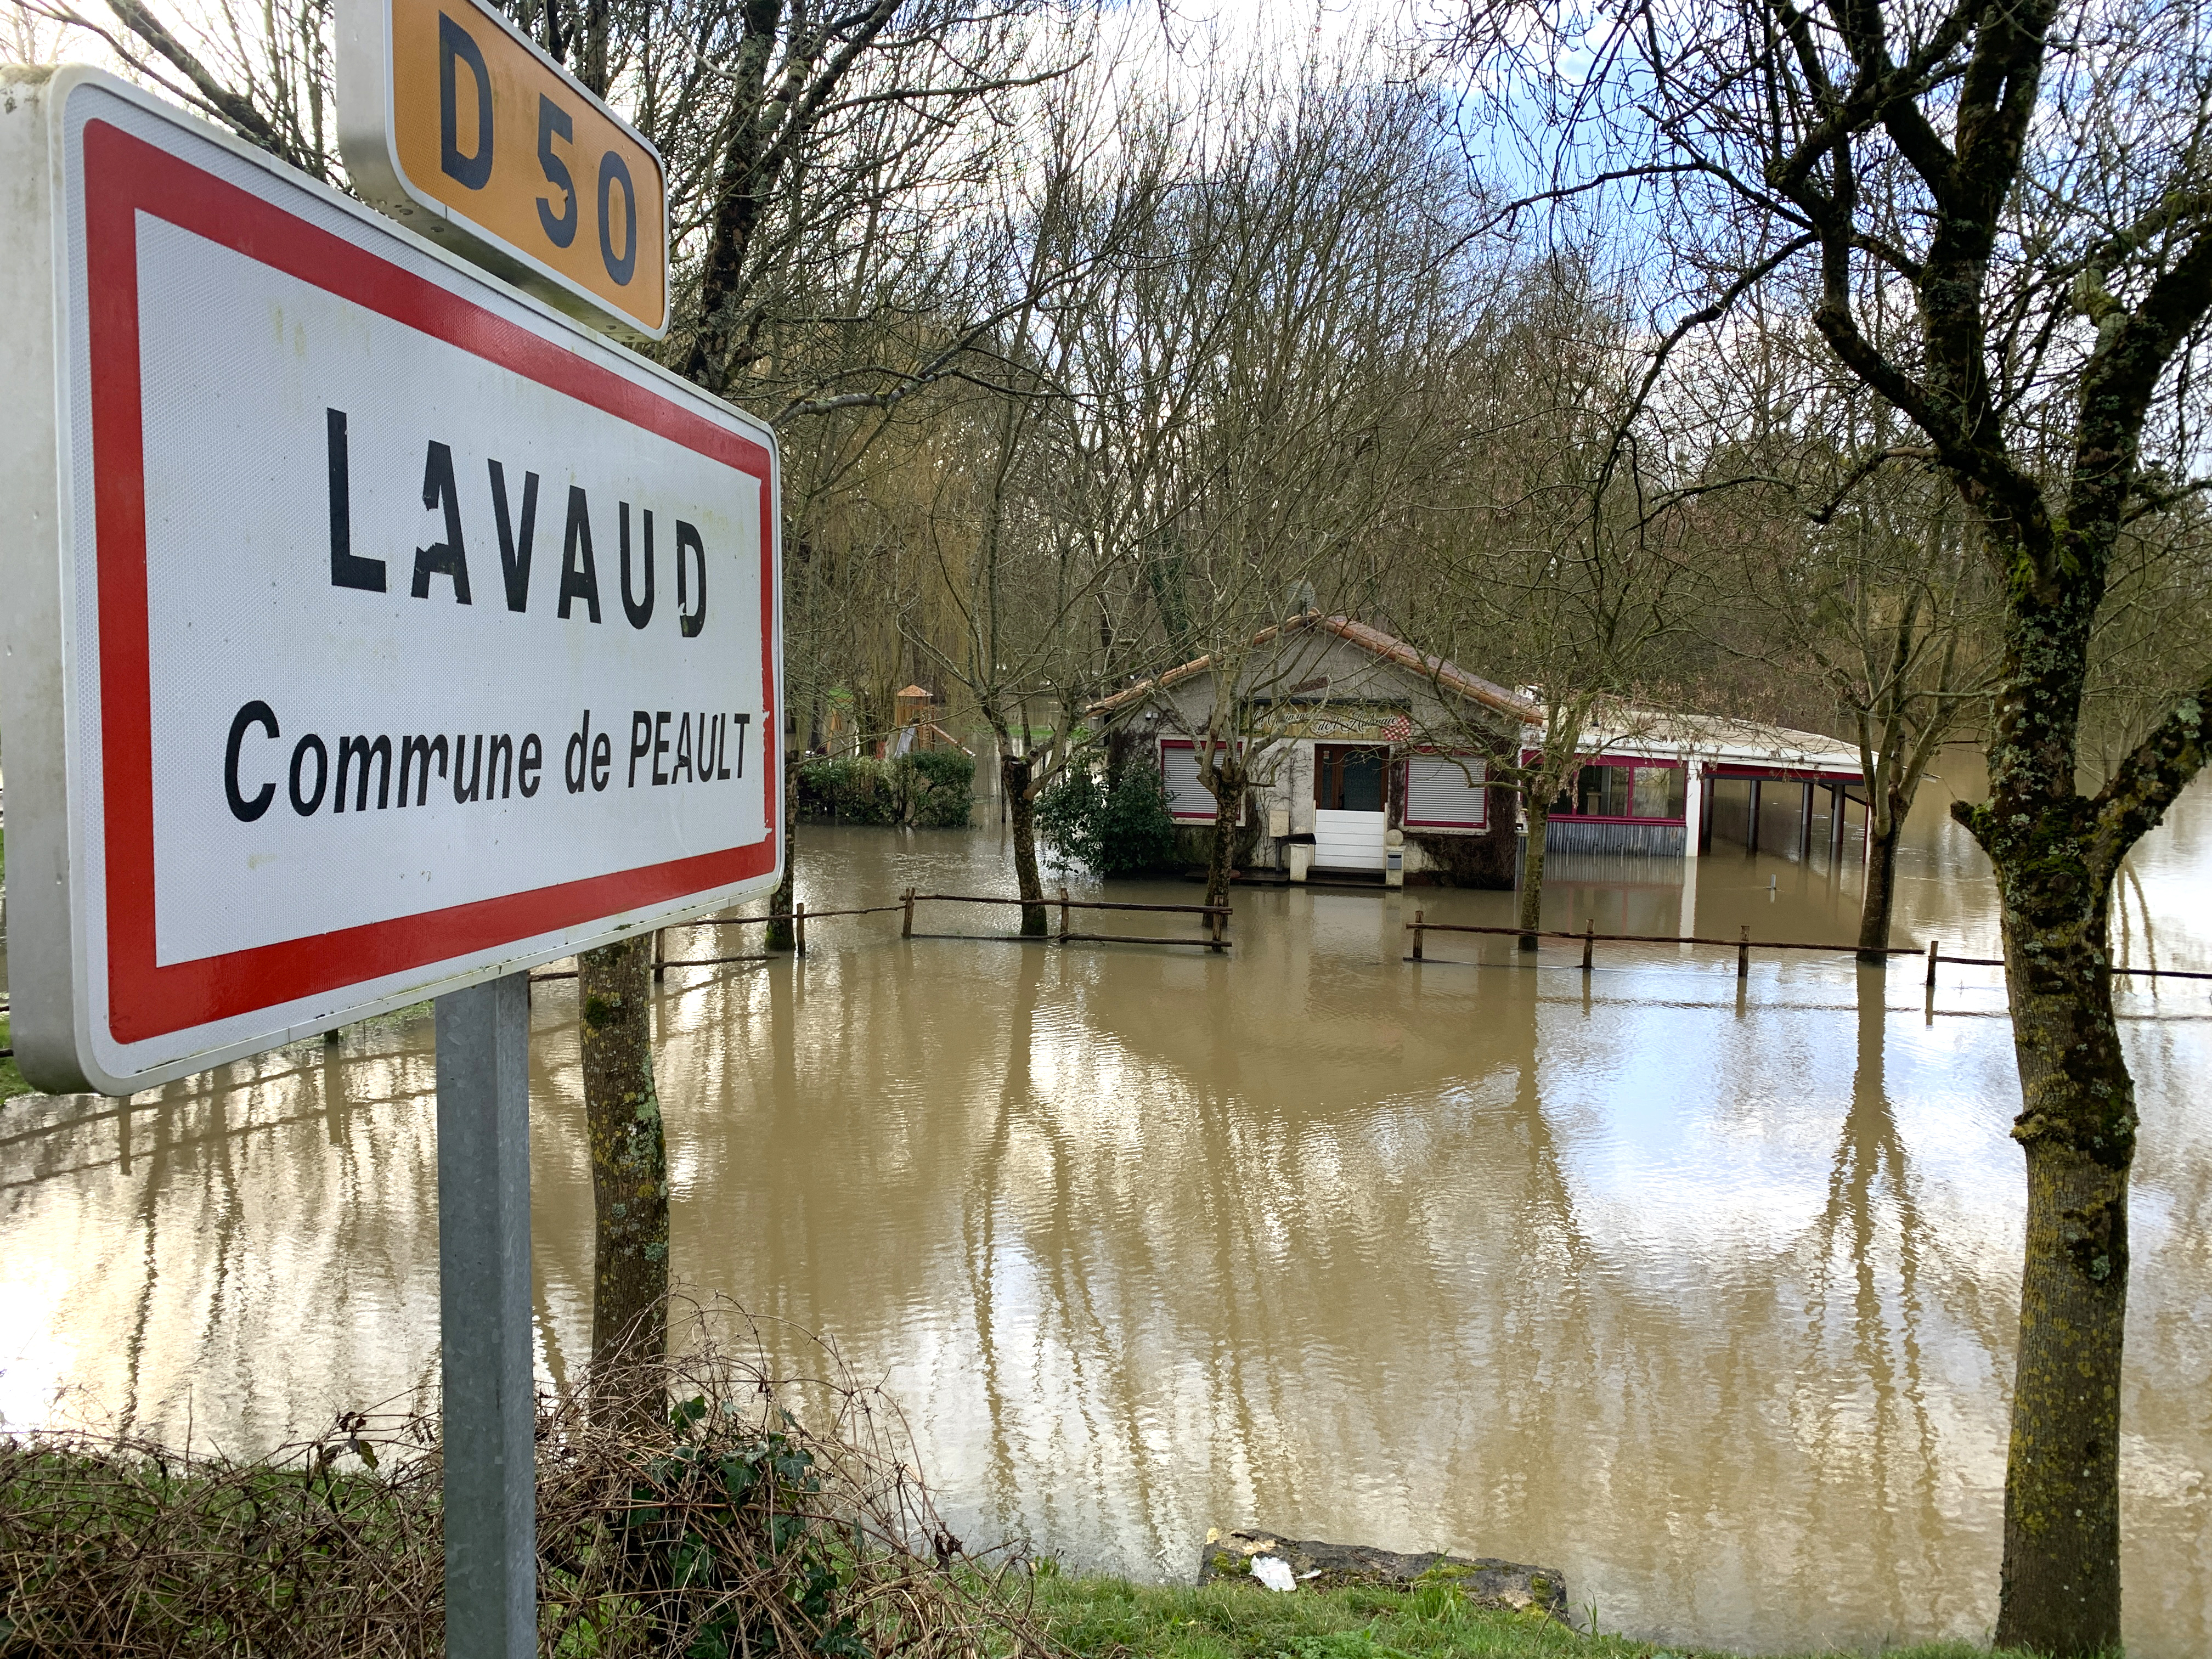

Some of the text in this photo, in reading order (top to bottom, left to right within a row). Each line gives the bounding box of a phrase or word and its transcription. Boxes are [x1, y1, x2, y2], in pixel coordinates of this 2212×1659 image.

[438, 9, 637, 287] D 50
[326, 407, 707, 639] LAVAUD
[224, 699, 751, 823] Commune de PEAULT
[1318, 720, 1332, 731] de
